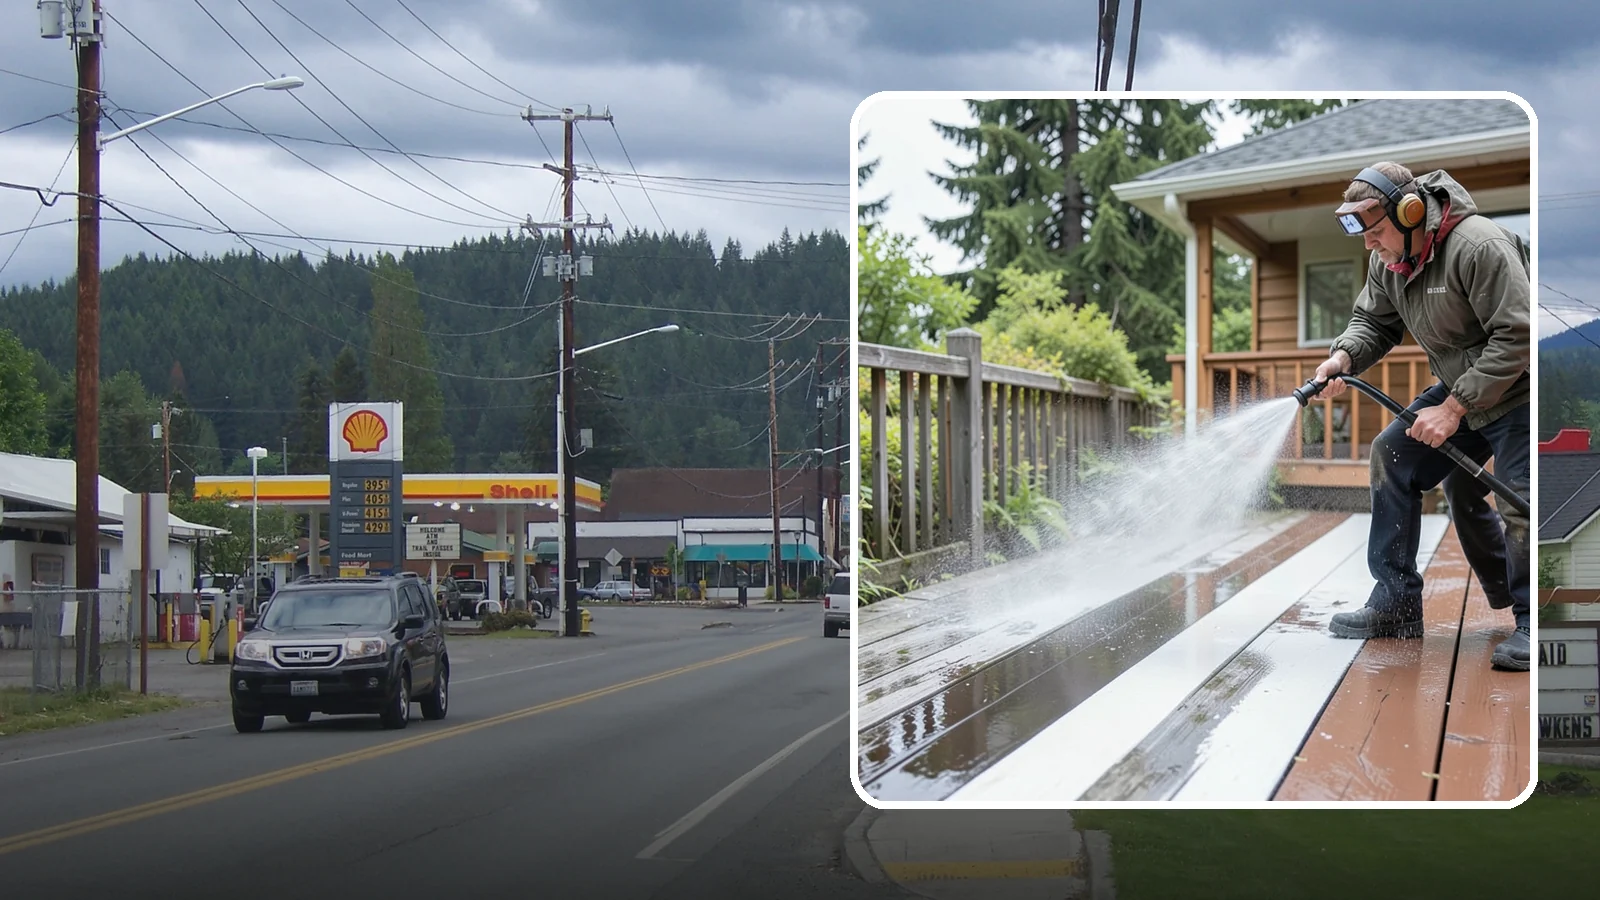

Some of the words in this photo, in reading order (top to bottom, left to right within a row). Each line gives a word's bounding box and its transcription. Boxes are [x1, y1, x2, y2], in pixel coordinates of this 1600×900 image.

[366, 480, 383, 490] 395
[490, 484, 547, 499] Shell
[366, 494, 383, 504] 405
[366, 507, 383, 518] 415
[366, 522, 383, 533] 429
